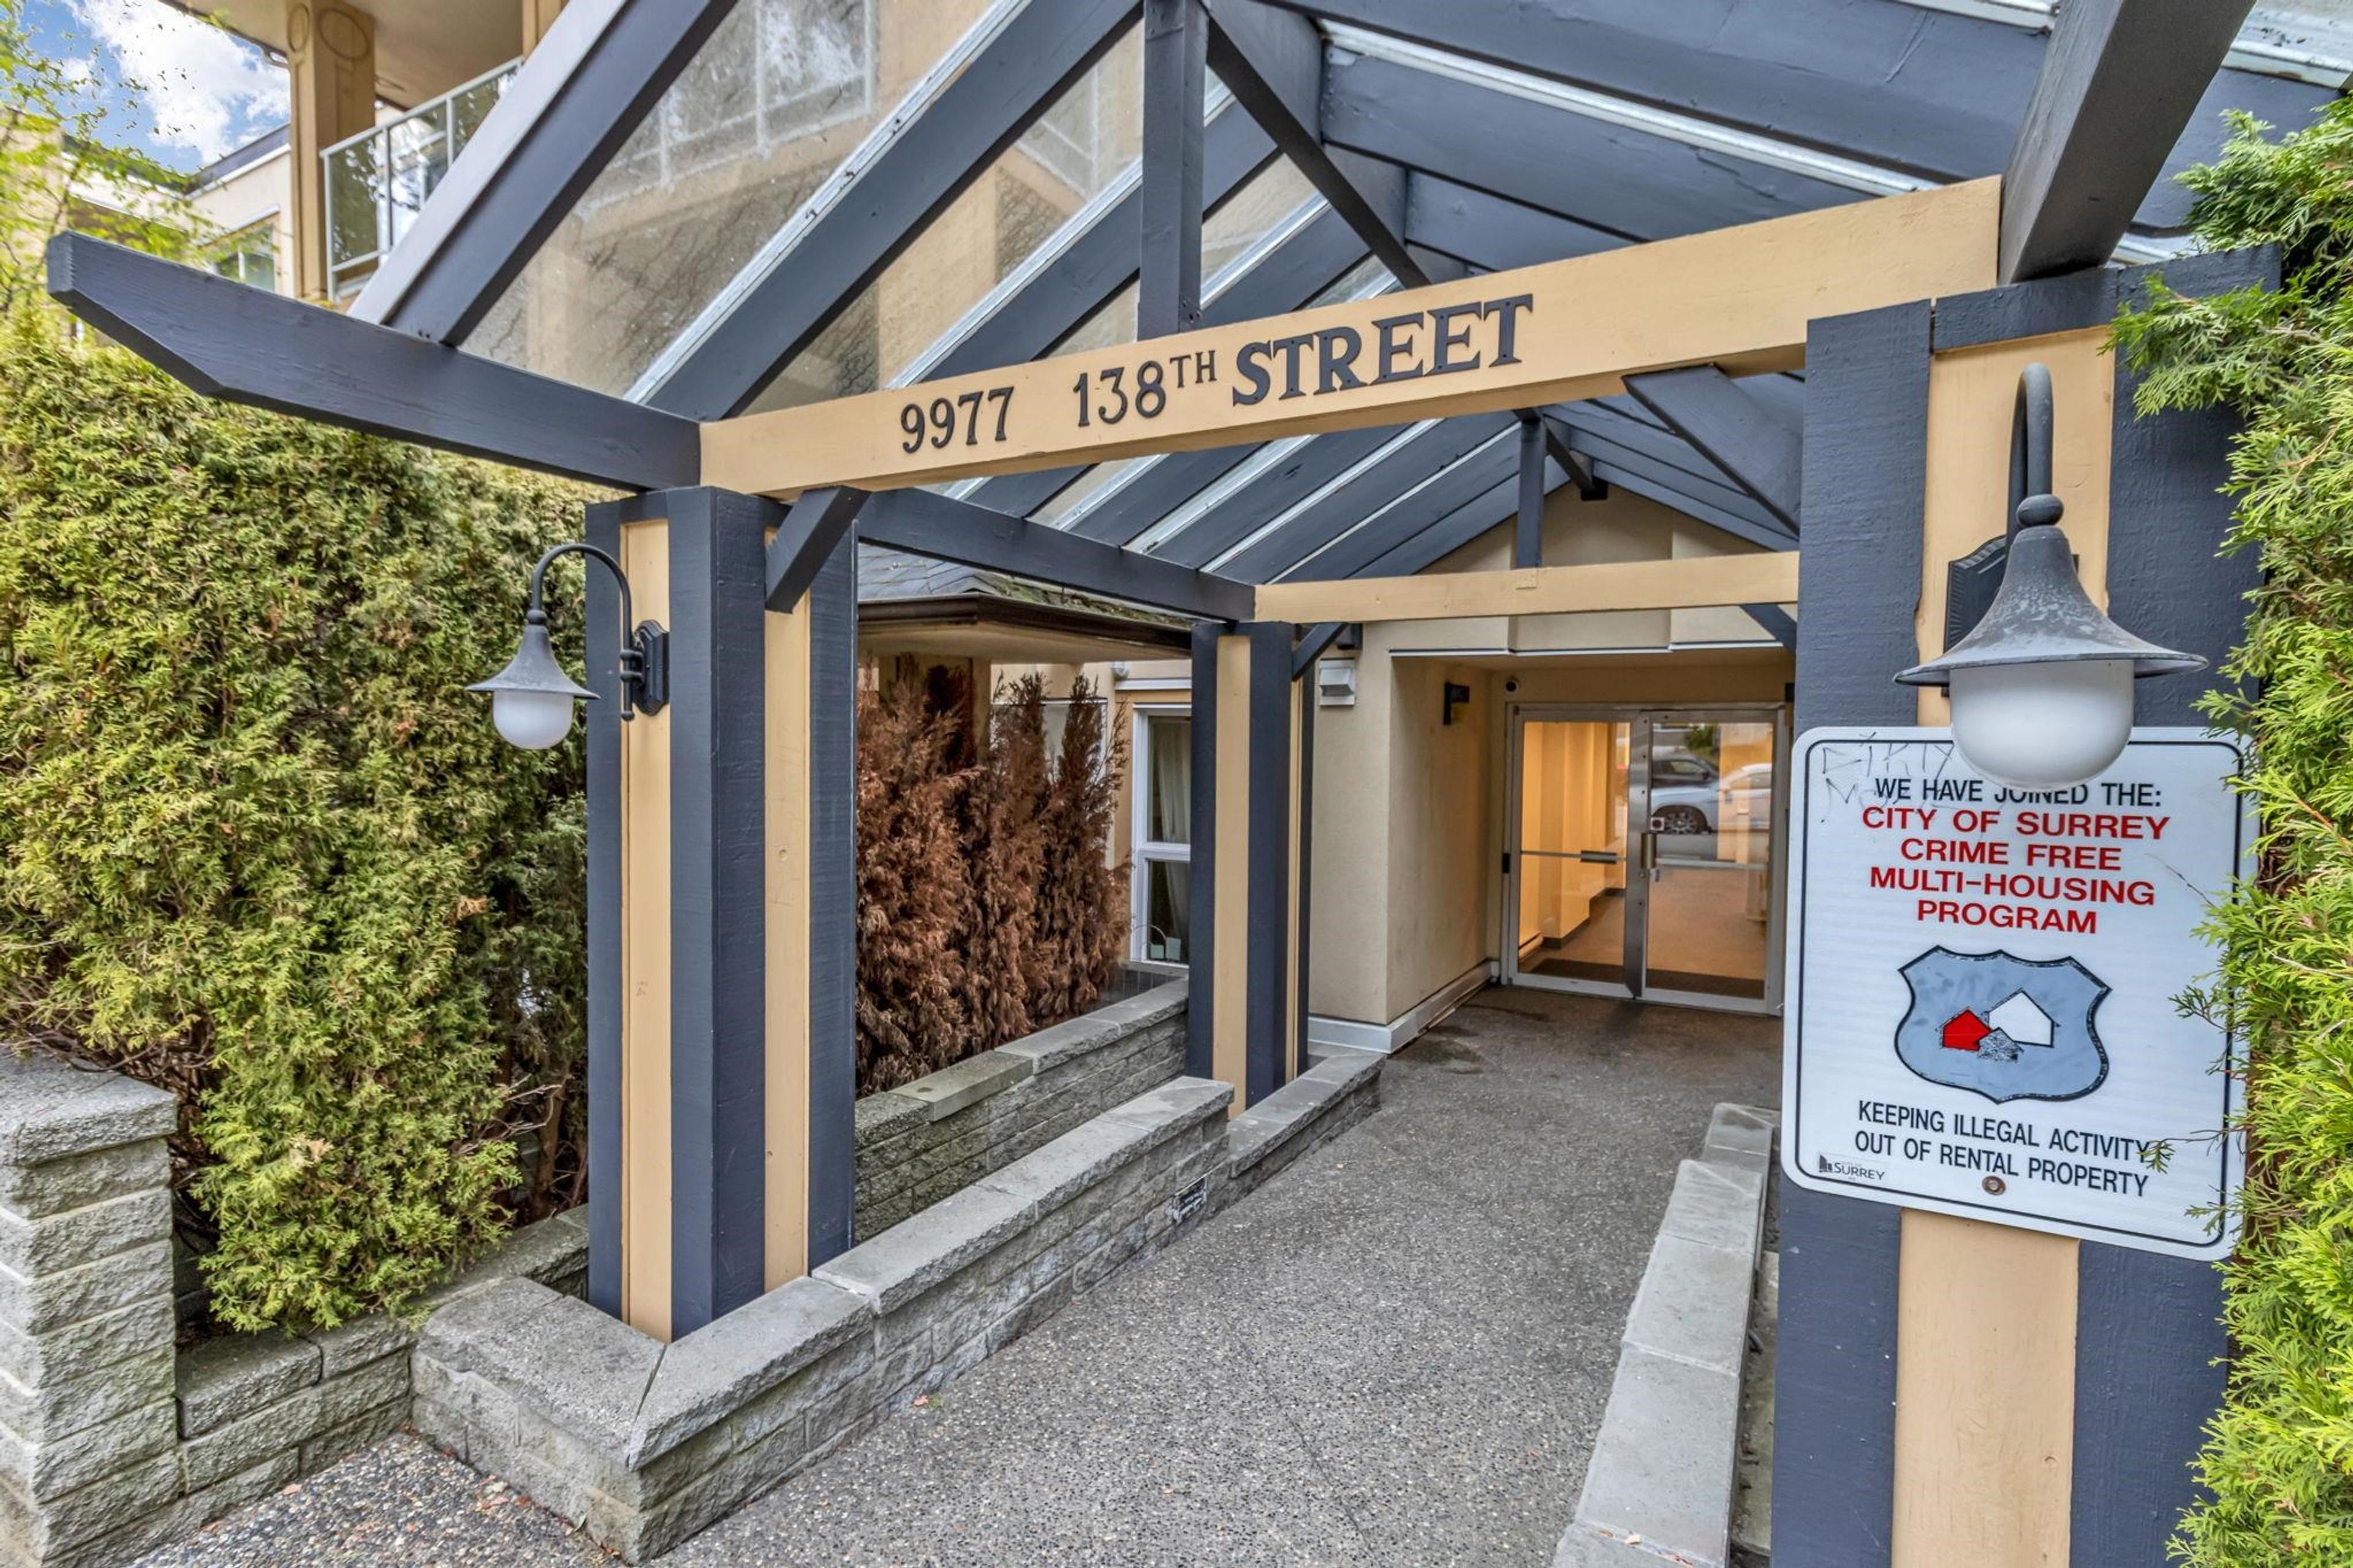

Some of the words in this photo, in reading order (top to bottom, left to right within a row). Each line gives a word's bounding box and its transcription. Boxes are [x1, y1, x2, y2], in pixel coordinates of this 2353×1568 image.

[900, 385, 1015, 454] 9977
[1232, 293, 1533, 407] STREET
[1875, 778, 1911, 800] WE
[1922, 778, 1984, 802] HAVE
[2101, 782, 2161, 807] THE:
[1862, 806, 1938, 830] CITY
[1953, 809, 2001, 833] OF
[2016, 811, 2171, 839] SURREY
[1901, 838, 2009, 865] CRIME
[2026, 844, 2122, 872] FREE
[1870, 866, 2155, 906] MULTI-HOUSING
[1917, 899, 2097, 934] PROGRAM
[1859, 1100, 1945, 1133] KEEPING
[1954, 1113, 2040, 1147] ILLEGAL
[2048, 1127, 2150, 1164] ACTIVITY
[1834, 1162, 1885, 1181] SURREY
[1855, 1130, 1896, 1156] OUT
[1904, 1138, 1932, 1161] OF
[1940, 1143, 2020, 1176] RENTAL
[2028, 1157, 2149, 1197] PROPERTY
